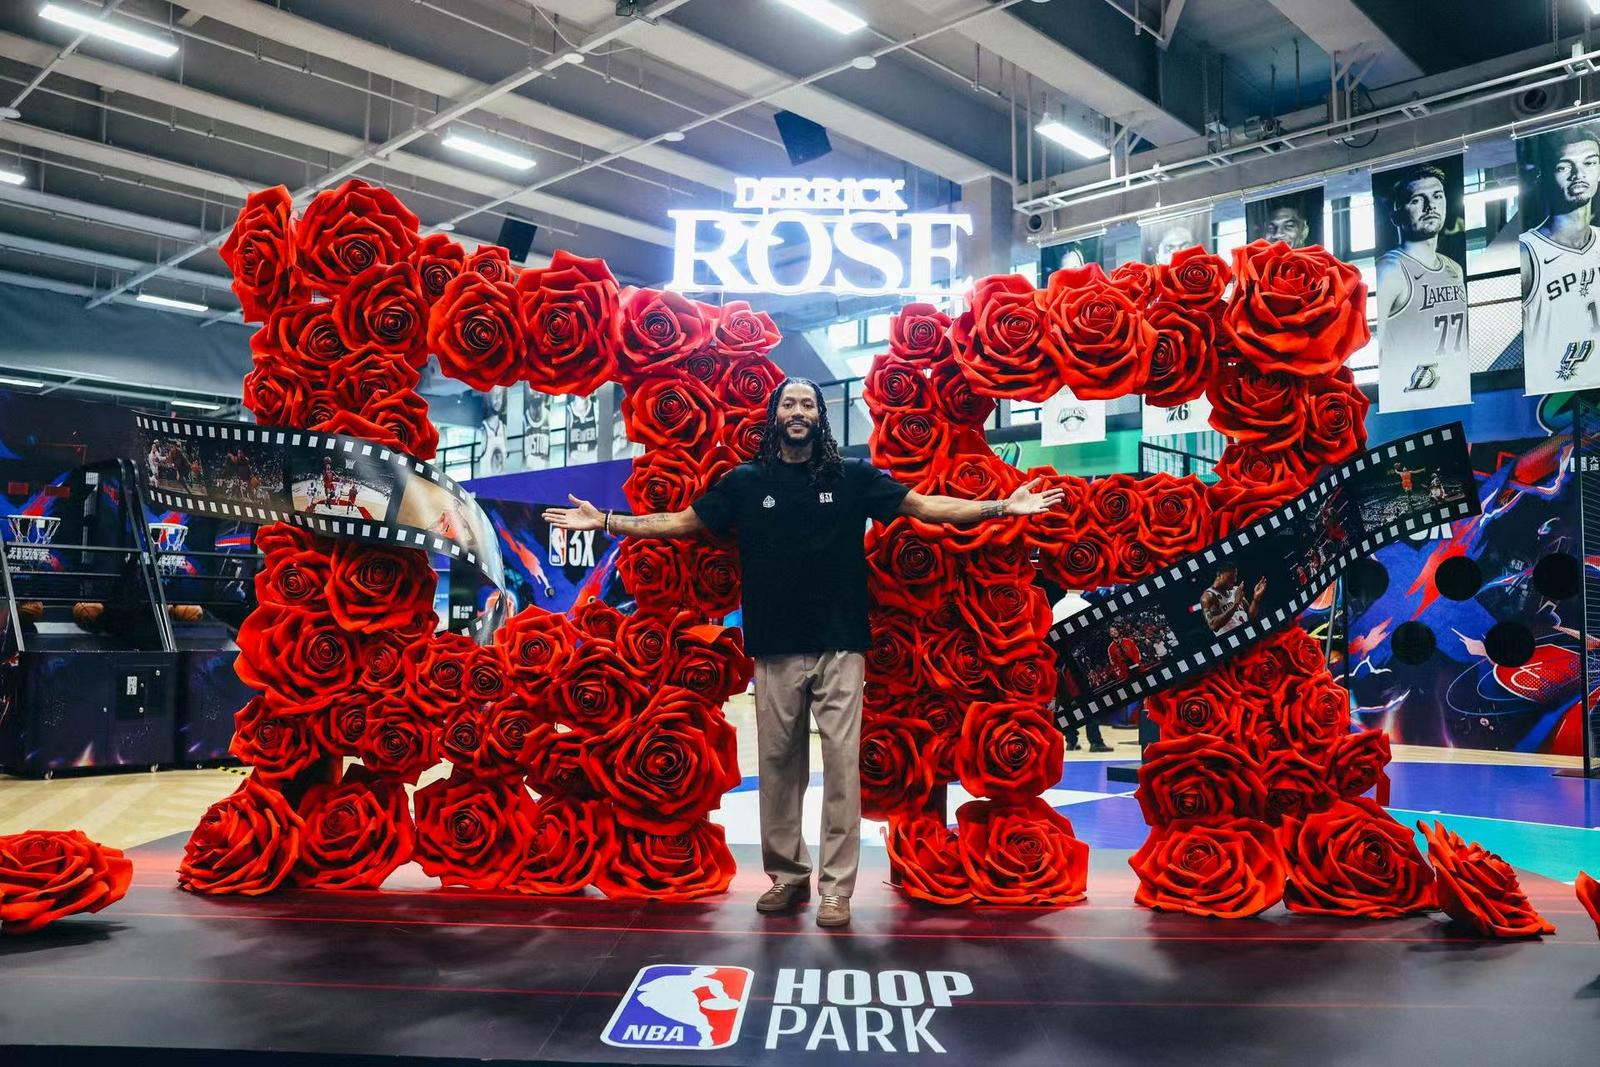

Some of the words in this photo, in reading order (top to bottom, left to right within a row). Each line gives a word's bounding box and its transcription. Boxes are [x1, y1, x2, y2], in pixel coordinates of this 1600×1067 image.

[733, 177, 907, 210] DERRICK
[665, 208, 973, 296] ROSE
[1418, 284, 1467, 312] LAKERS
[1546, 267, 1600, 302] SPU
[1433, 313, 1465, 356] 77
[773, 968, 974, 1007] HOOP
[622, 1024, 684, 1042] NBA
[764, 1004, 947, 1053] PARK
